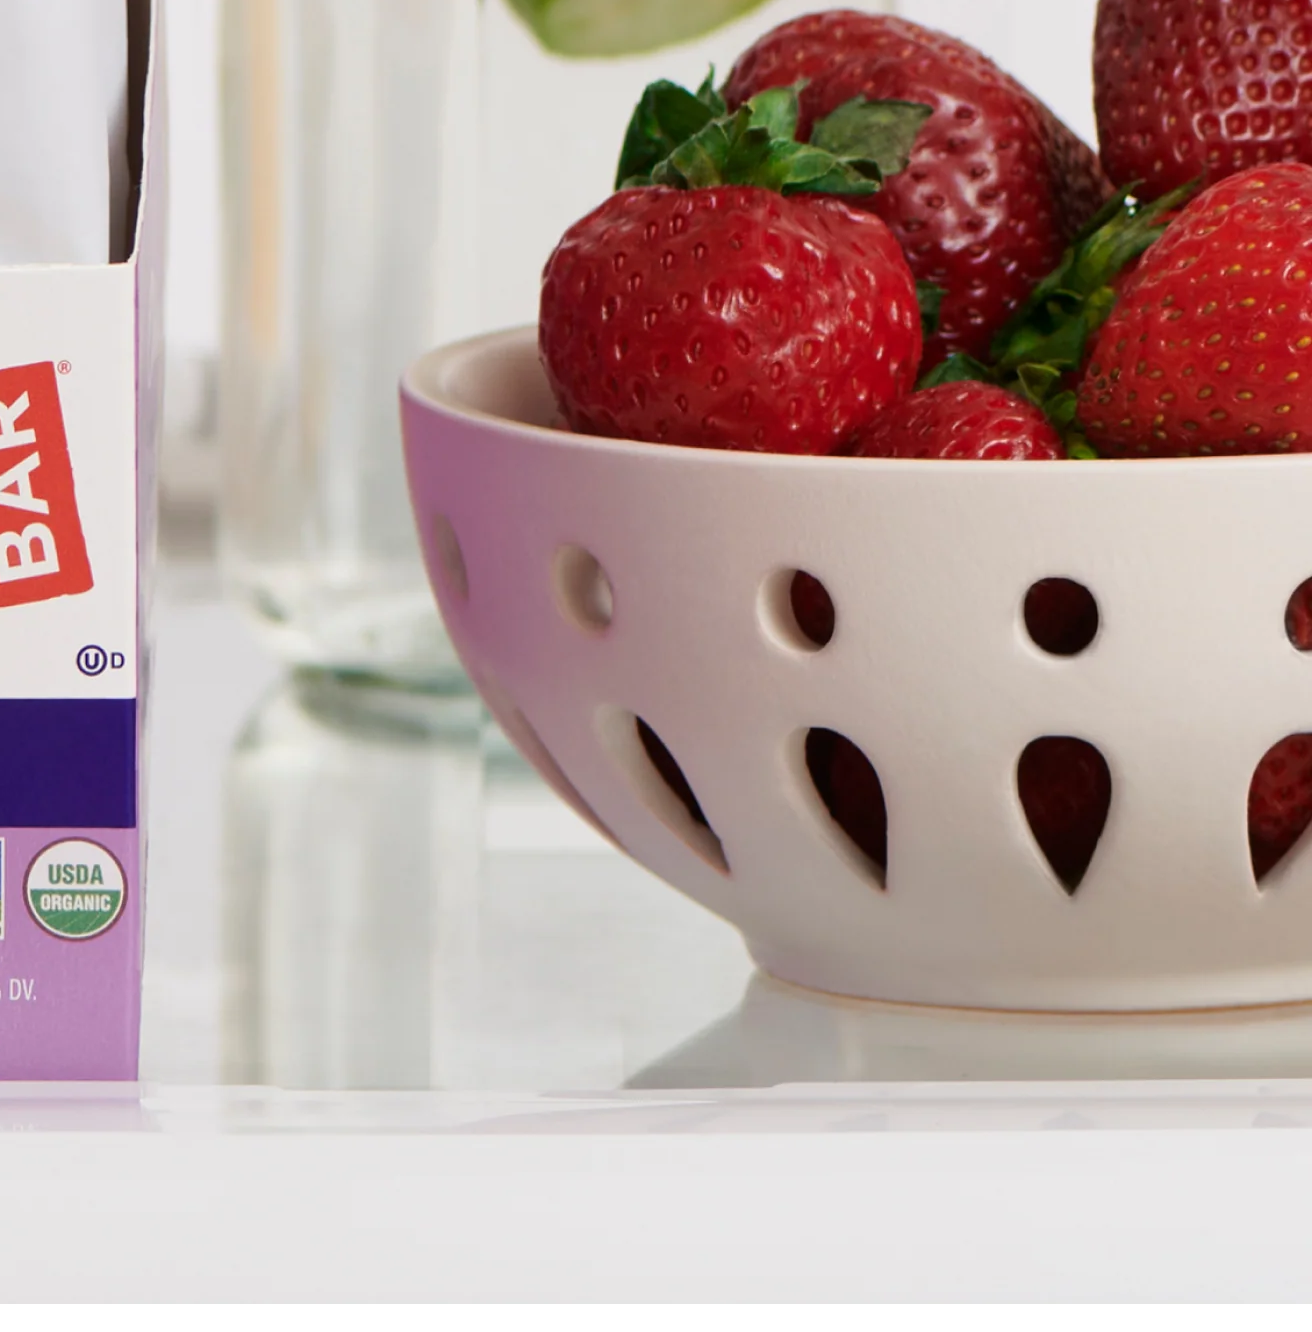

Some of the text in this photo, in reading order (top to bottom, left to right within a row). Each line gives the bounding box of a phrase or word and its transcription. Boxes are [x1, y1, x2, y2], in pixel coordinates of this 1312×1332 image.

[48, 863, 104, 885] USDA
[39, 894, 112, 912] ORGANIC
[8, 978, 37, 1001] DV.
